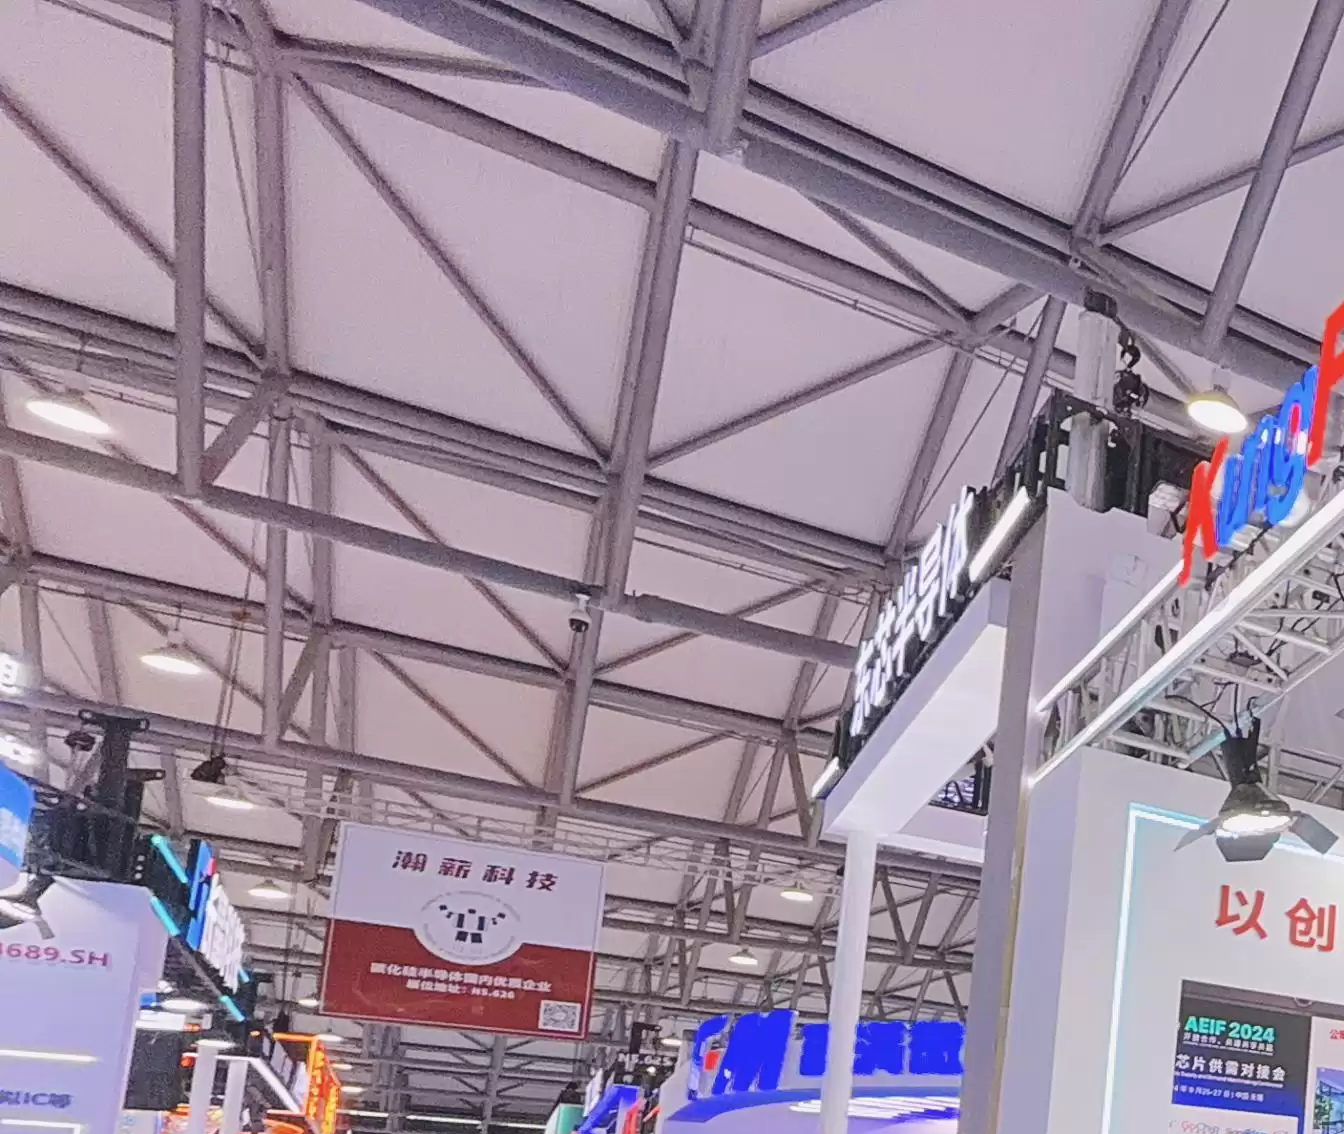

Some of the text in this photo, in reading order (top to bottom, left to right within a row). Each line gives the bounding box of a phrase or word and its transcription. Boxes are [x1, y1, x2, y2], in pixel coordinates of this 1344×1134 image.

[0, 942, 110, 968] 689.SH
[1184, 1015, 1276, 1043] AEIF 2024
